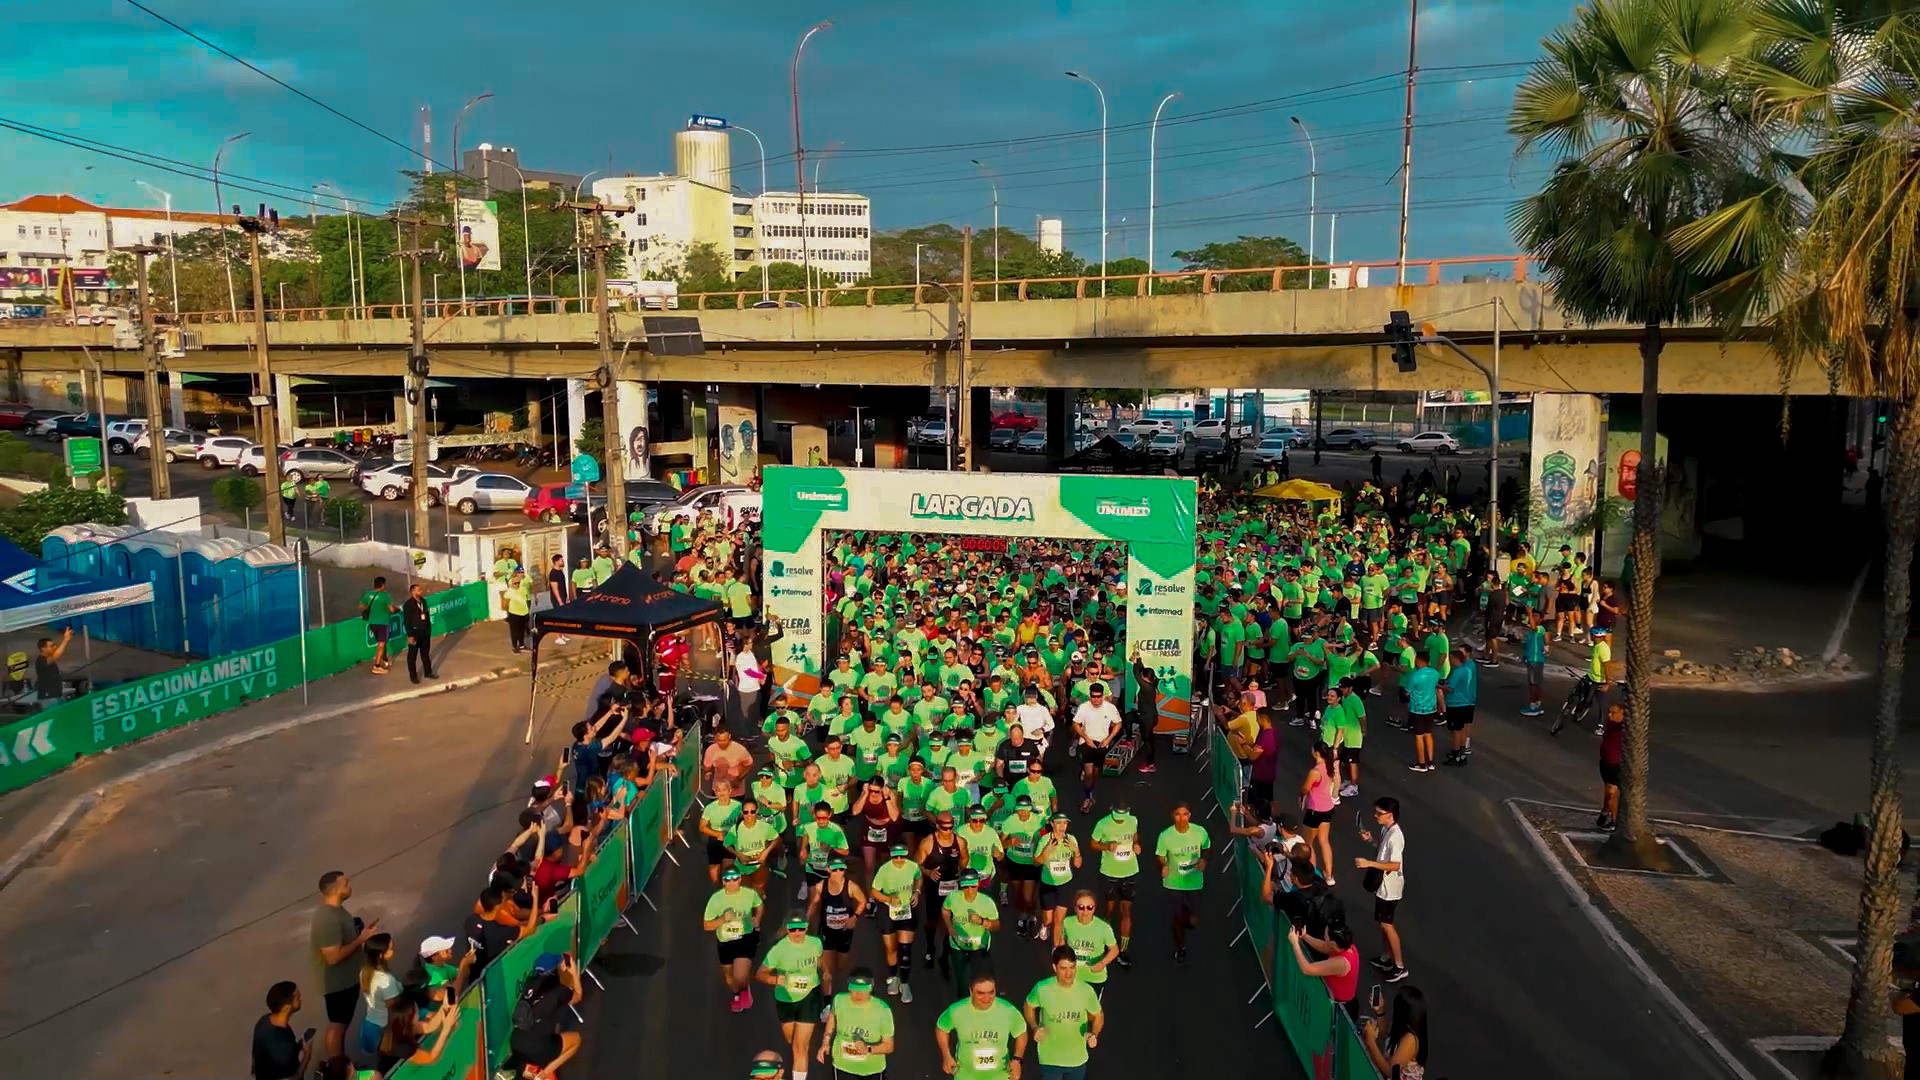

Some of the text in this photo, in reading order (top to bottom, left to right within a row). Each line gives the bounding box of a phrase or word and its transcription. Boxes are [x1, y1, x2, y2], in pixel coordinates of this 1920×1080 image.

[910, 493, 1034, 521] LARGADA
[1096, 505, 1150, 516] UNIMED
[785, 565, 814, 576] resolve
[1154, 584, 1185, 593] resolve
[1149, 607, 1183, 616] intermed
[1136, 639, 1181, 651] ACELERA
[91, 646, 276, 721] ESTACIONAMENTO
[93, 671, 277, 744] ROTATIVO
[978, 1055, 995, 1065] 705
